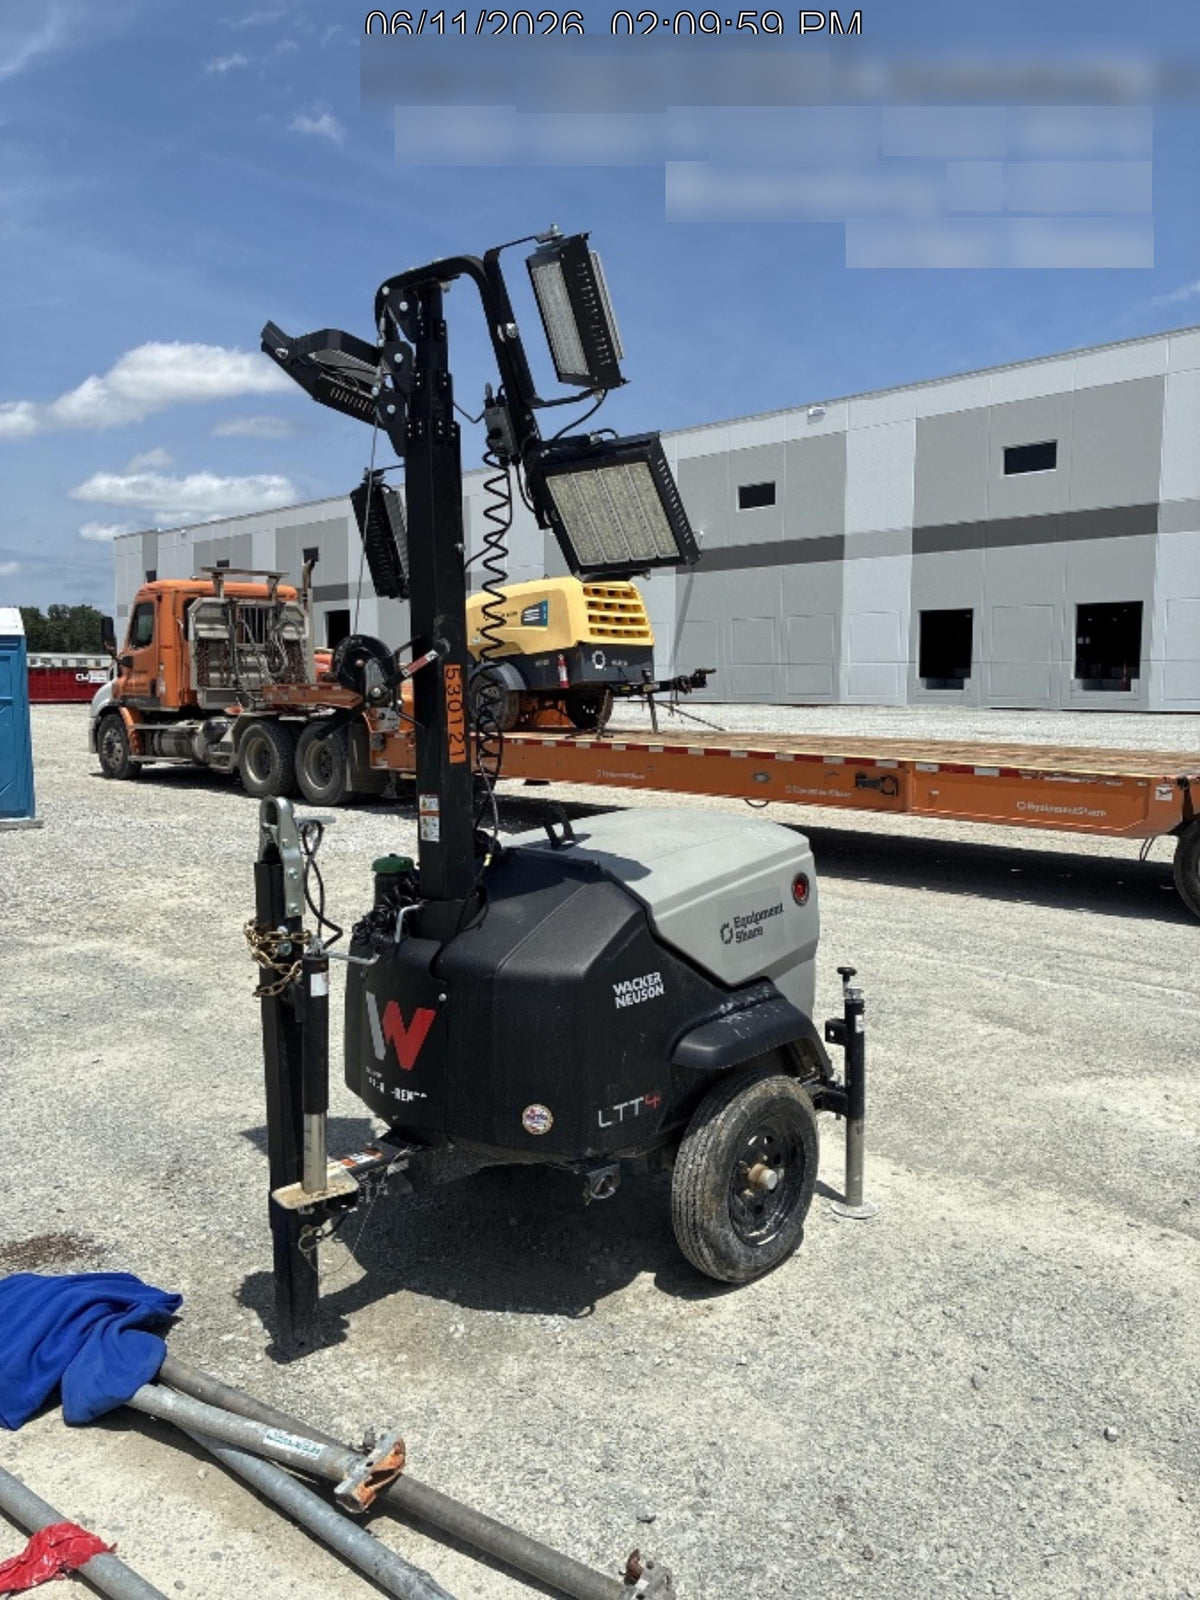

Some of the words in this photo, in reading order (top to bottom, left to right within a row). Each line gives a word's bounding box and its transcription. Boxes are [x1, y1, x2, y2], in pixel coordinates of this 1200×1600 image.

[445, 667, 466, 758] 530121
[612, 972, 662, 996] WACKER
[614, 983, 665, 1009] NEUSON
